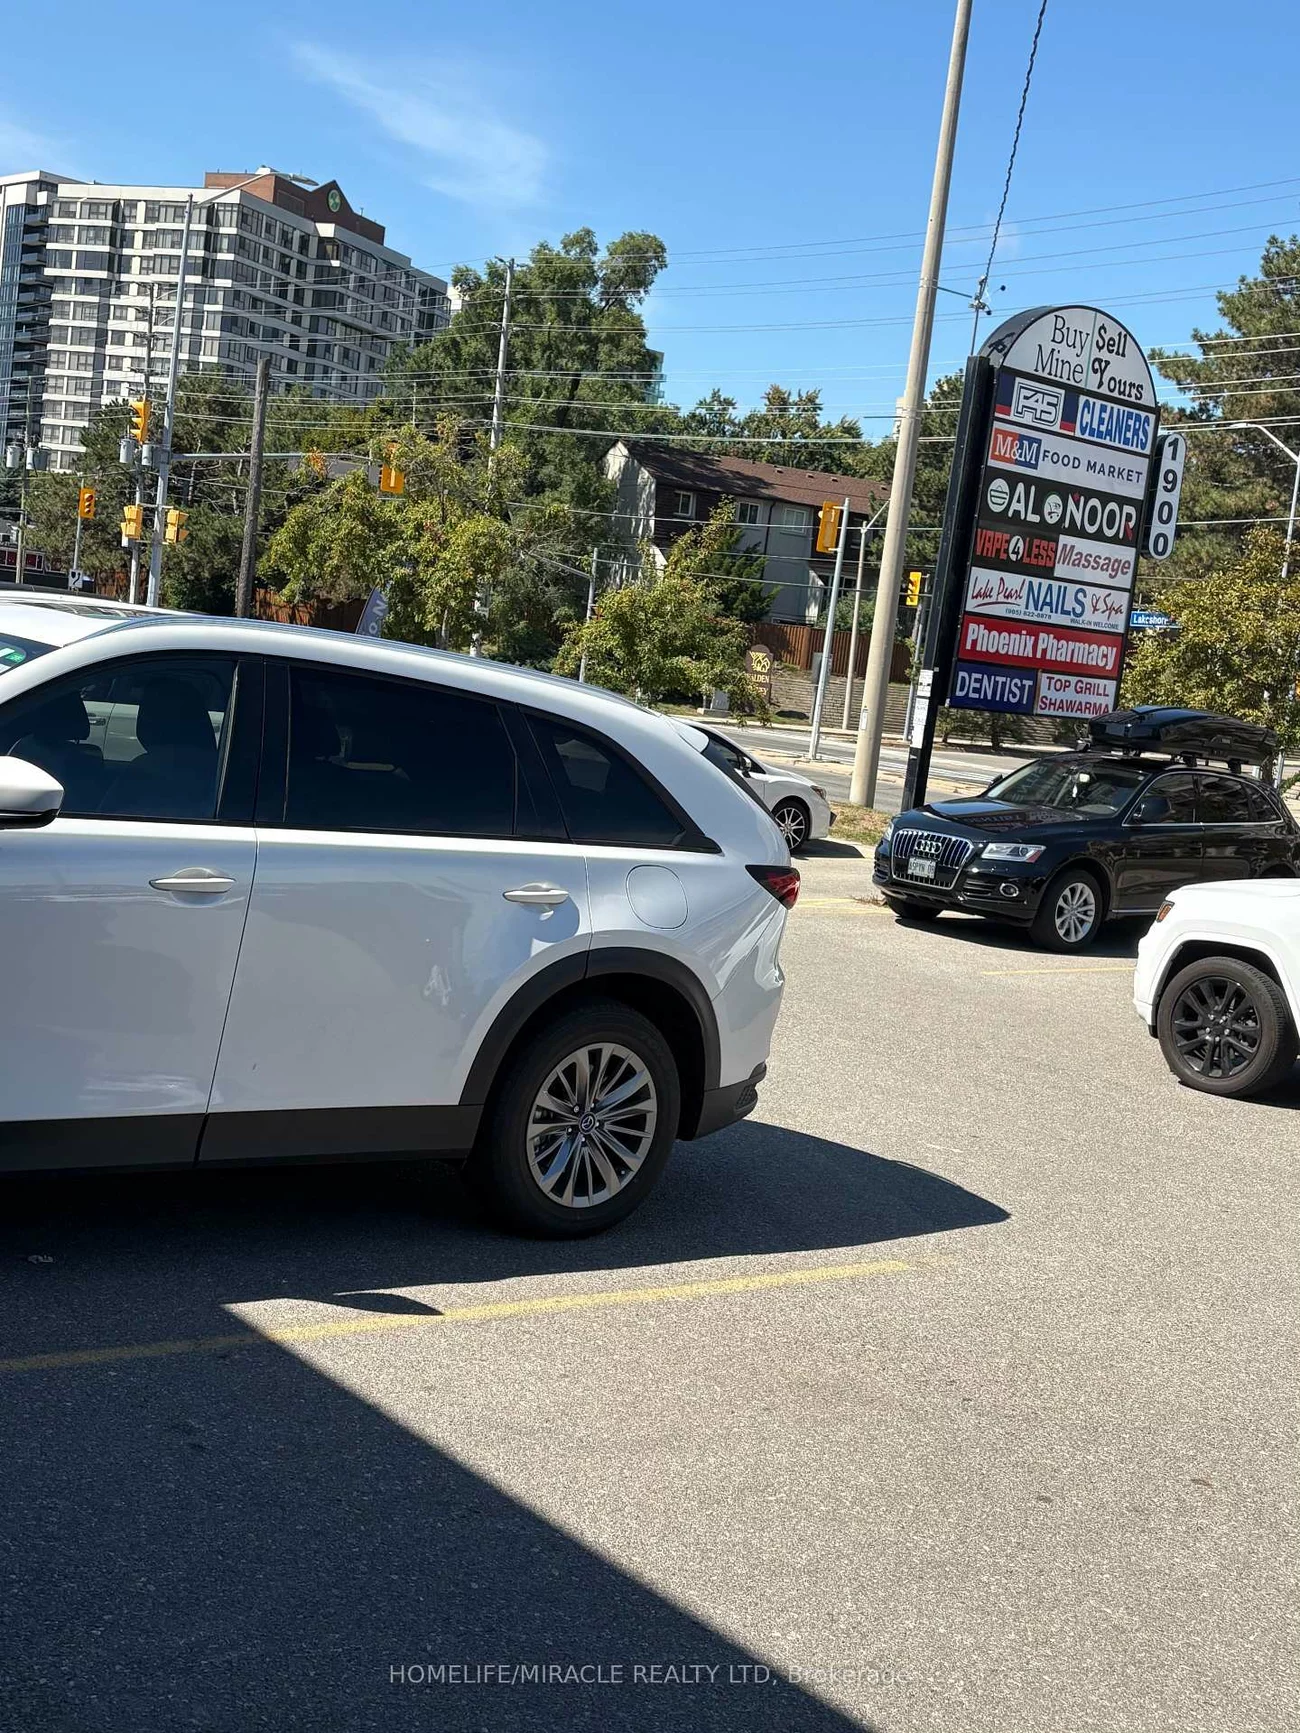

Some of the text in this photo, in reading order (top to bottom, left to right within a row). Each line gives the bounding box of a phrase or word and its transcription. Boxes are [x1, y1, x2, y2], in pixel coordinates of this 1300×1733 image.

[1050, 314, 1090, 358] Buy
[1033, 343, 1144, 401] Mine Yours
[1078, 398, 1150, 451] CLEANERS
[994, 433, 1143, 484] M&M FOOD MARKET
[1007, 481, 1137, 541] AL NOOR
[1152, 437, 1179, 557] 1900
[1056, 543, 1132, 580] Massage
[971, 576, 993, 600] Lake
[1025, 580, 1087, 618] NAILS
[1101, 592, 1124, 621] Spa
[965, 623, 1116, 670] Phoenix Pharmacy
[955, 671, 1033, 705] DENTIST
[1039, 695, 1110, 716] SHAWARMA
[1046, 676, 1110, 697] TOP GRILL
